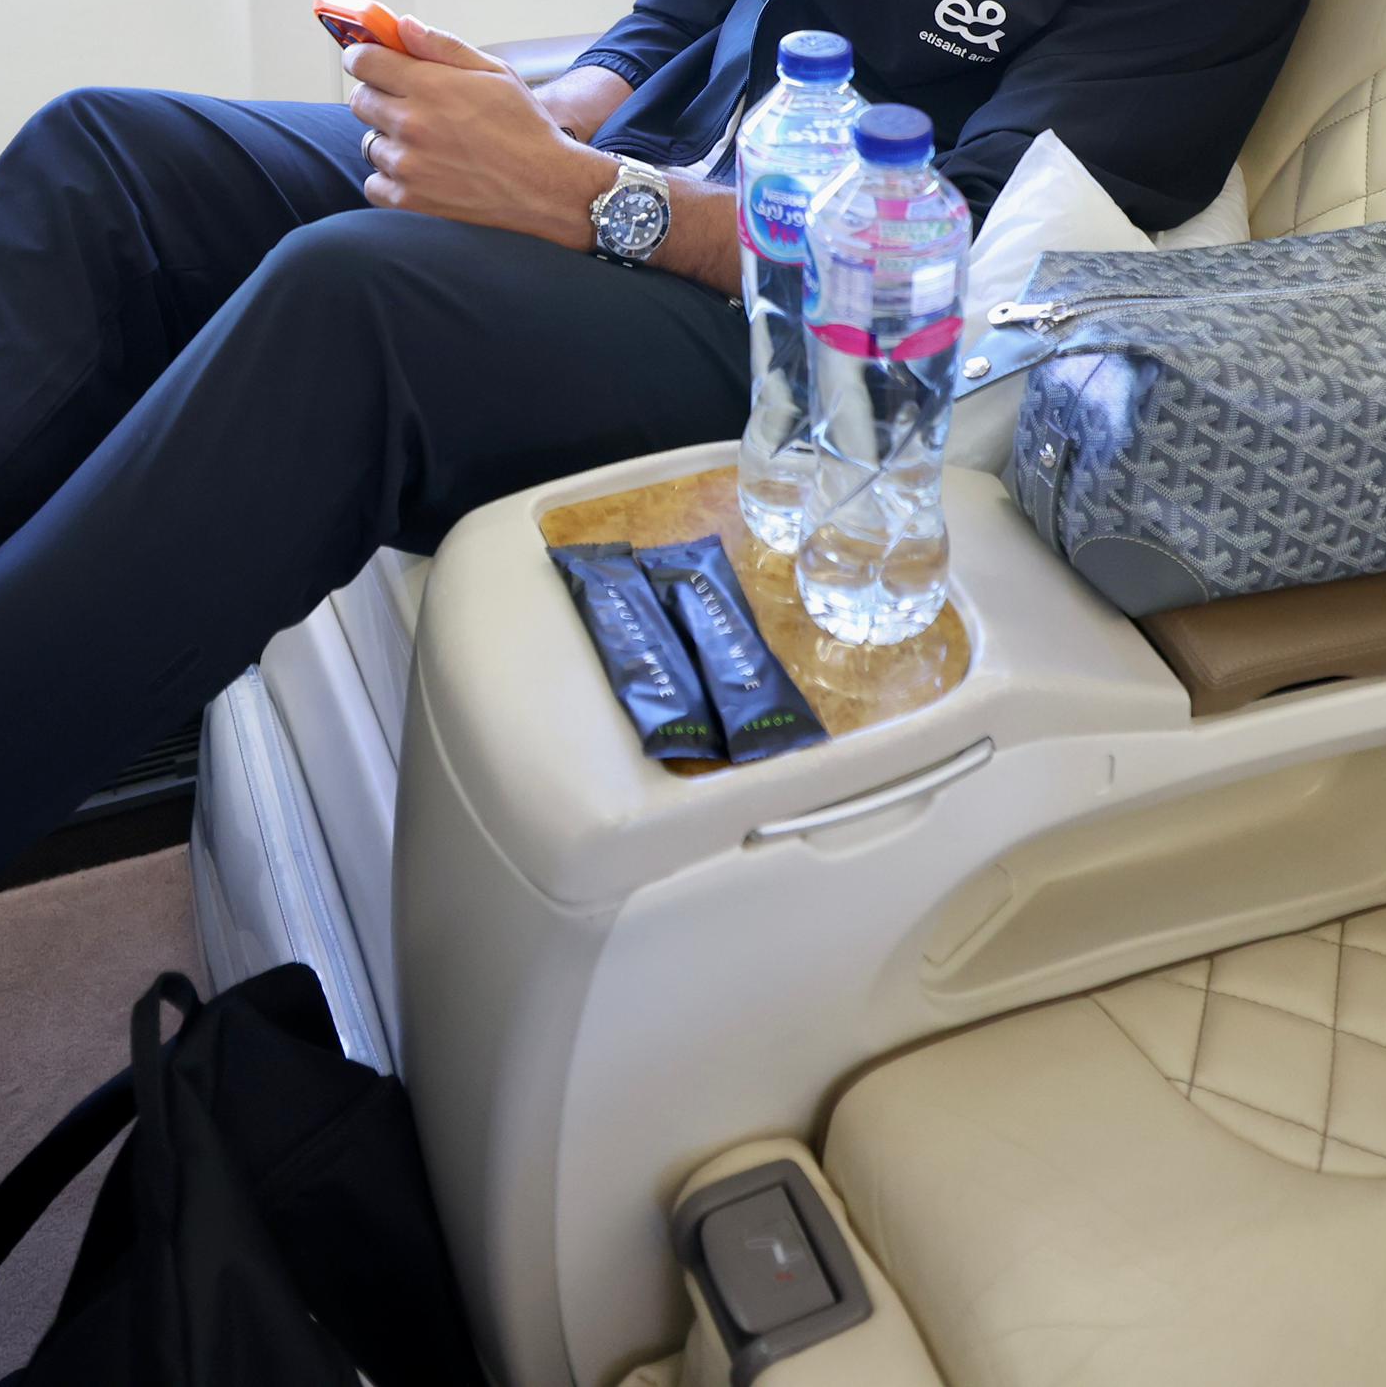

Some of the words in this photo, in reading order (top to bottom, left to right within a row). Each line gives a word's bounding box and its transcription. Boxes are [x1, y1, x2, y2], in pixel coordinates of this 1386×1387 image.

[919, 30, 968, 58] etisalat
[690, 572, 733, 636] LUXURY
[728, 643, 761, 691] WIPE
[642, 650, 676, 698] WIPE
[743, 714, 796, 732] LEMON
